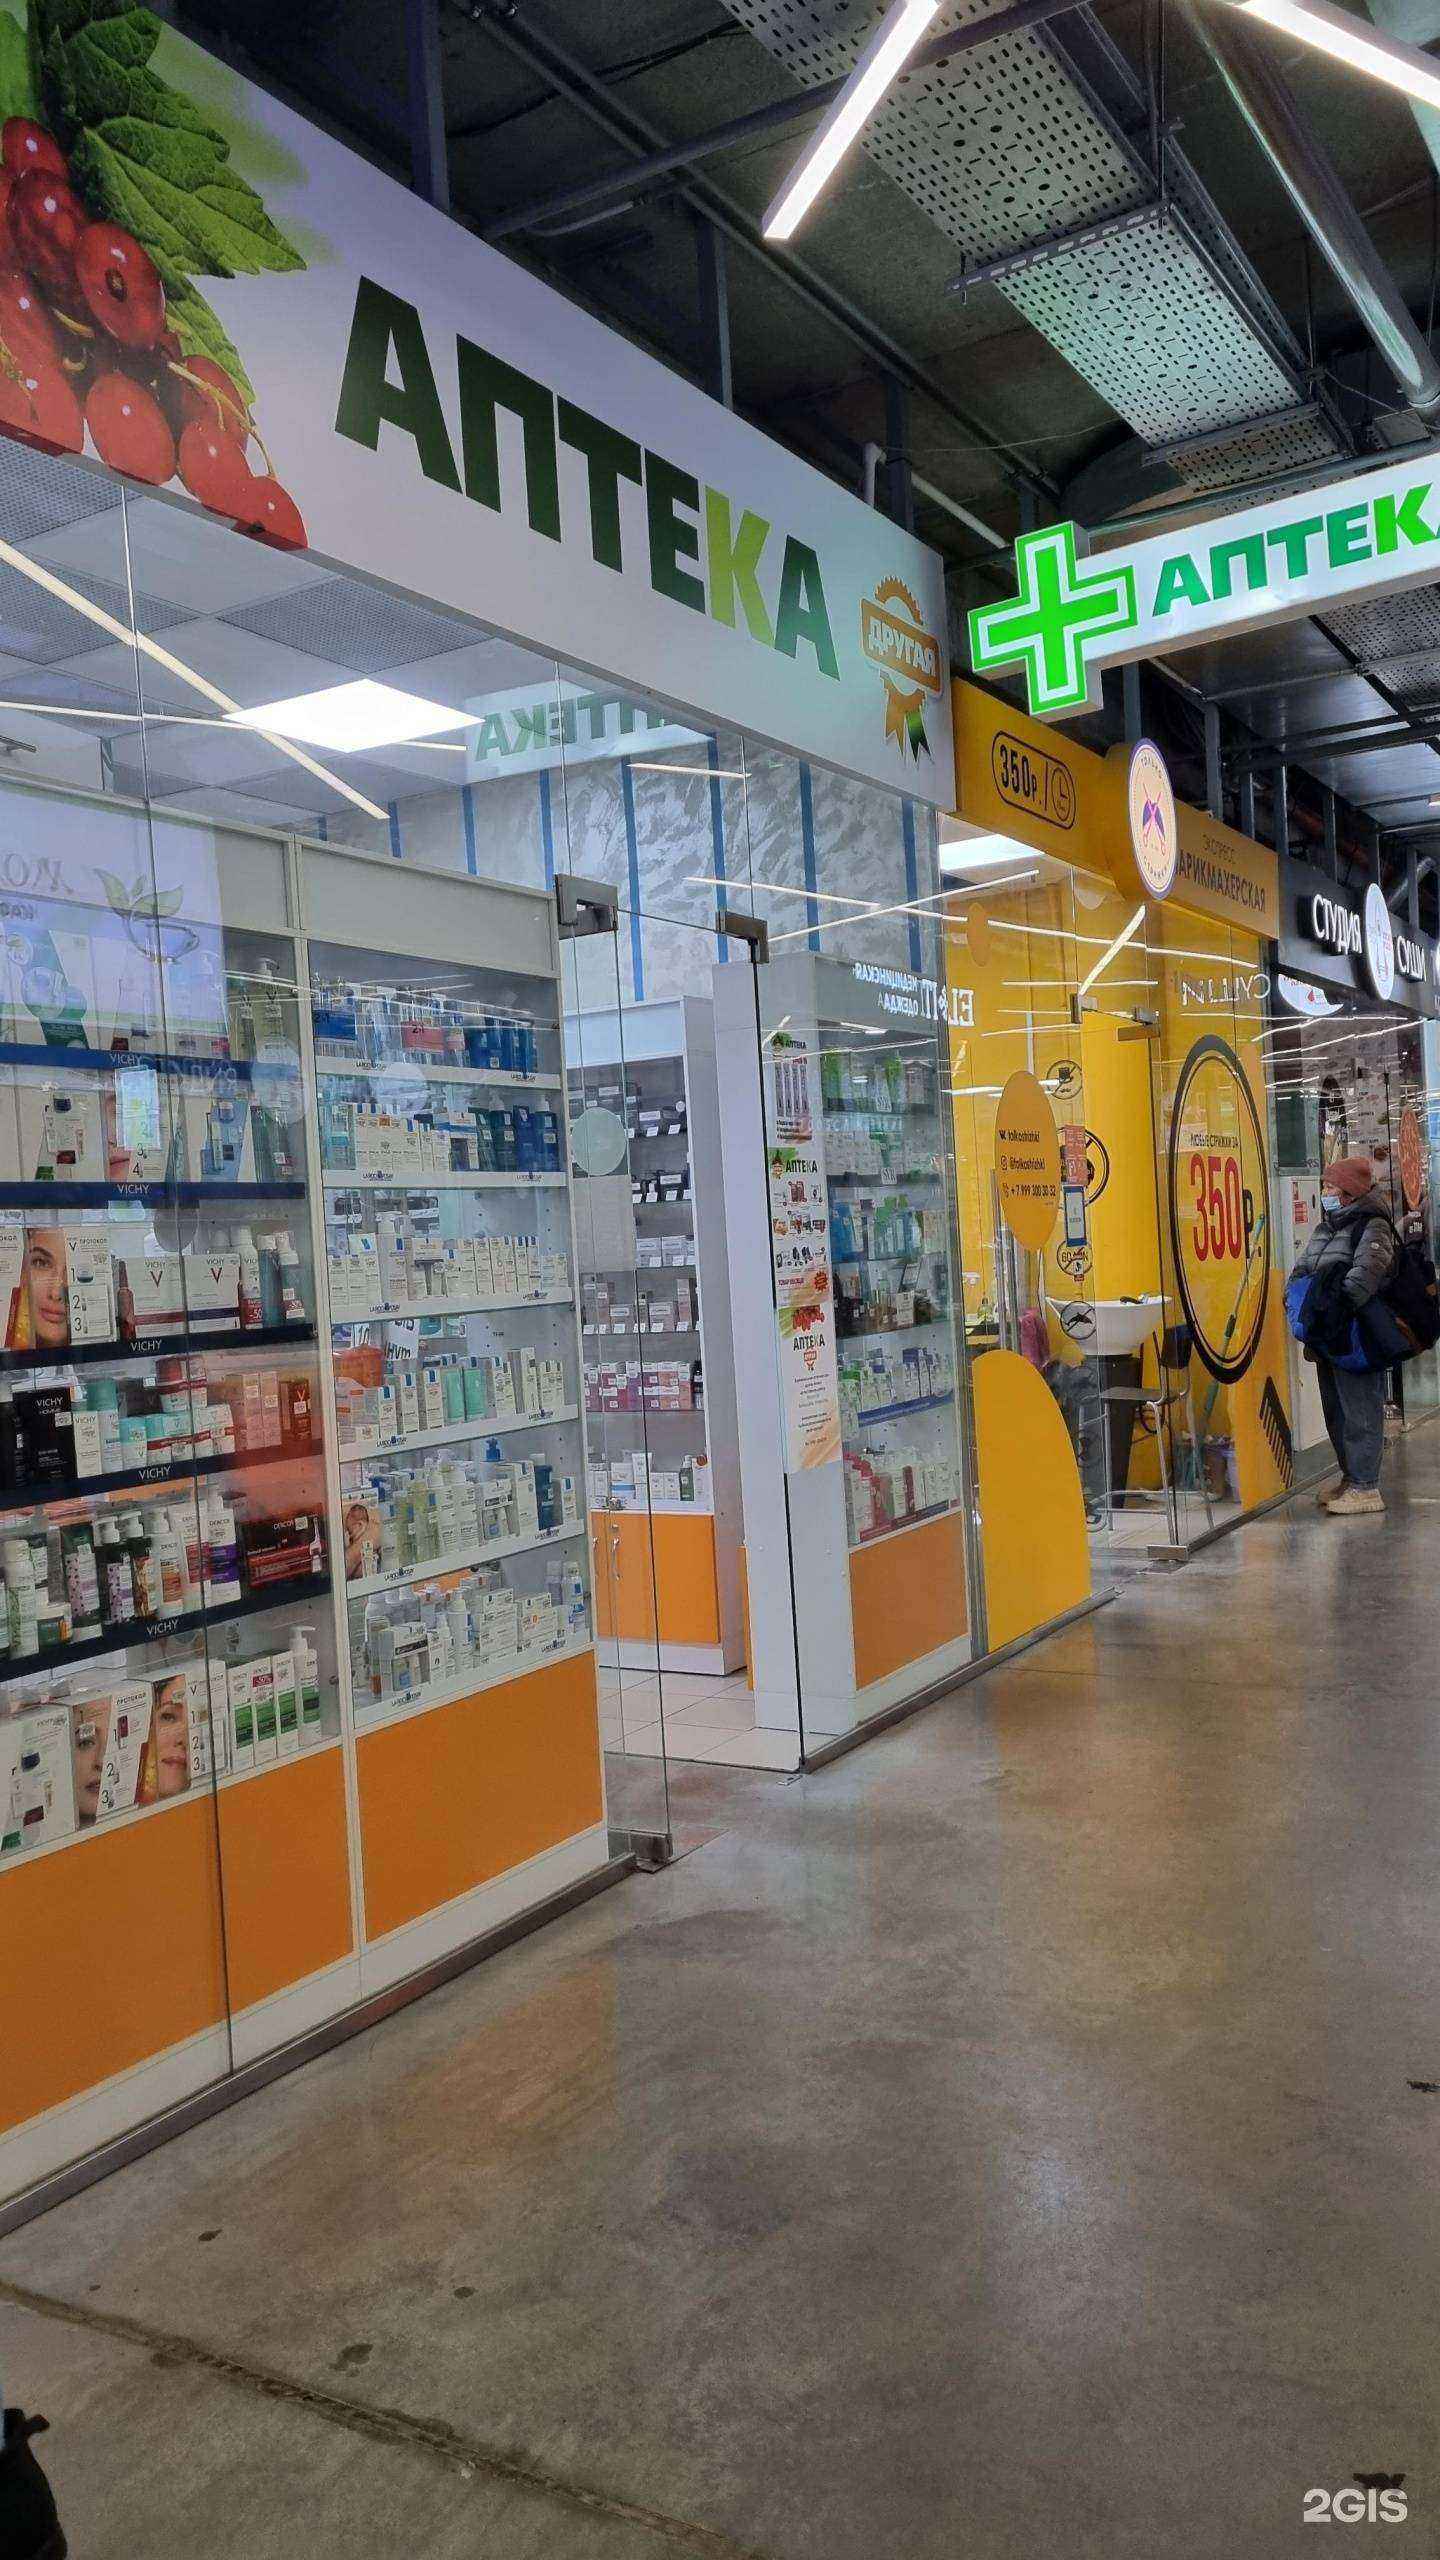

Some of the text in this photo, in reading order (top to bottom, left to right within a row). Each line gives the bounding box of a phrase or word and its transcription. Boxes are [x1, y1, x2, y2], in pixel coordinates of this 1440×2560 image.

[335, 274, 840, 682] АПТЕКА
[1152, 482, 1440, 616] АПТЕК
[868, 620, 936, 677] ДРУГАЯ
[1312, 893, 1363, 955] СТУДИЯ
[109, 1052, 142, 1066] VICHY
[786, 1159, 818, 1173] АПТЕКА
[117, 1184, 150, 1195] VICHY
[1191, 1153, 1242, 1261] 350
[130, 1339, 162, 1351] VICHY
[793, 1333, 826, 1352] АПТЕКА
[36, 1396, 63, 1408] VICHY
[139, 1465, 171, 1480] VICHY
[147, 1619, 178, 1636] VICHY
